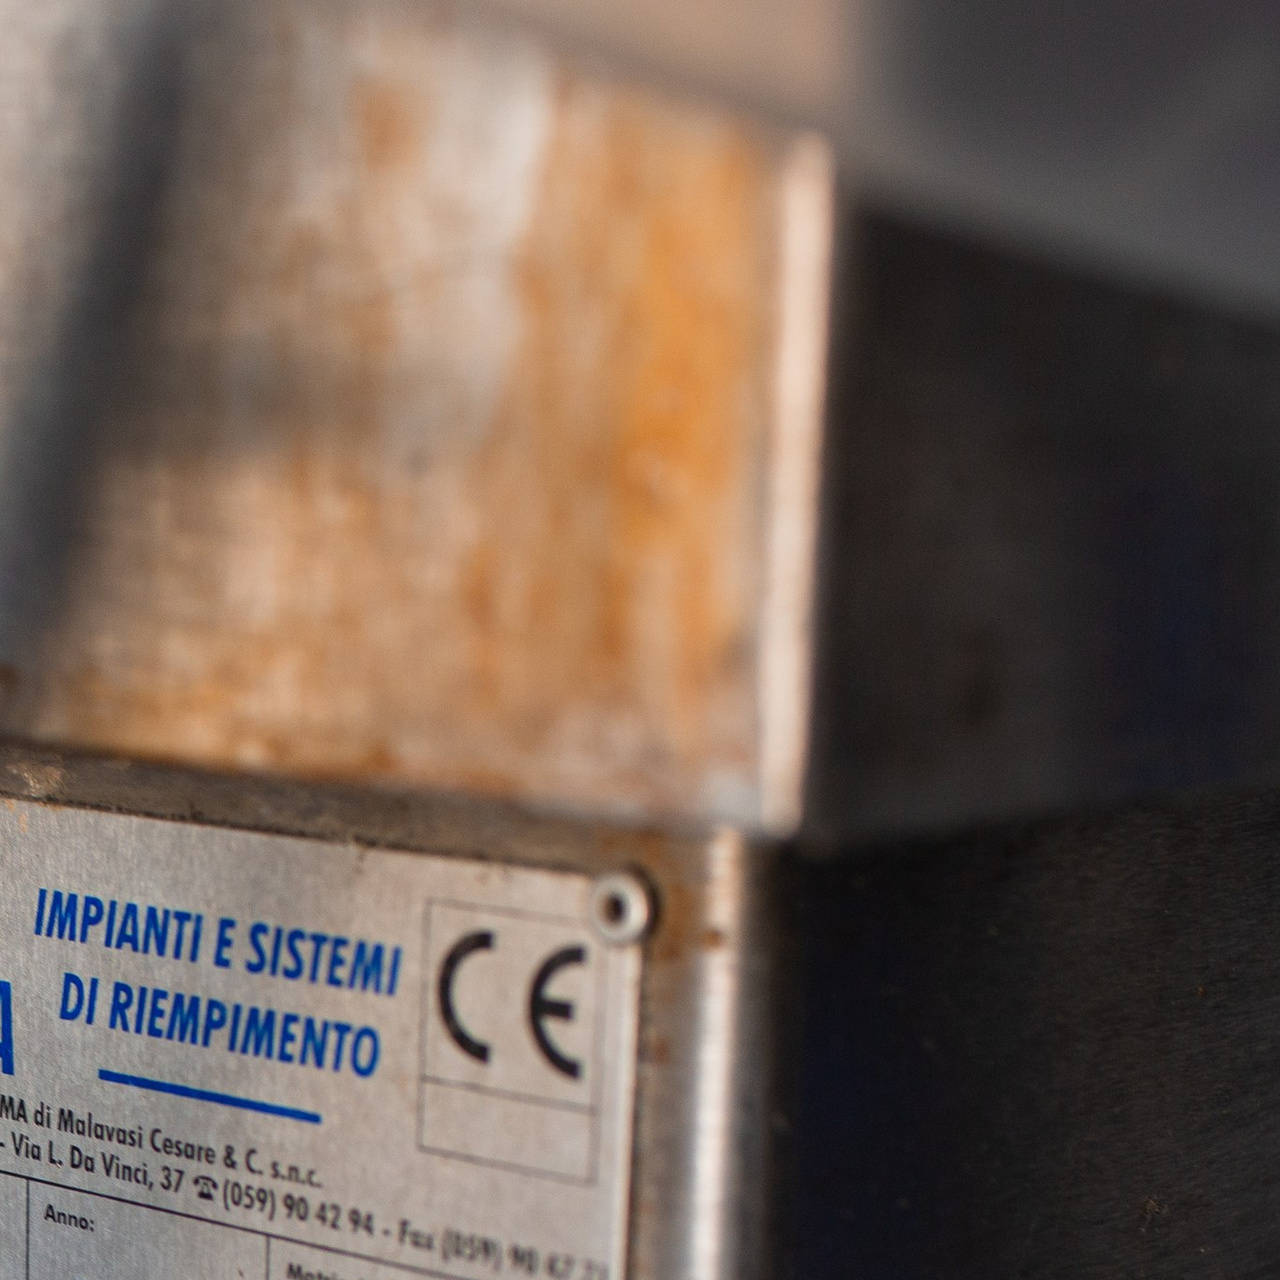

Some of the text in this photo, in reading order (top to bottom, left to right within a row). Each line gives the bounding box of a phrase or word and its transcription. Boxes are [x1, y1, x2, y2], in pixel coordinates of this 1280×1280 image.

[34, 888, 402, 996] IMPIANTI E SISTEMI
[59, 972, 381, 1078] DI RIEMPIMENTO
[438, 930, 587, 1081] CE
[11, 1131, 41, 1162] Via
[48, 1141, 63, 1166] L.
[70, 1146, 95, 1173] Da
[101, 1152, 154, 1191] Vinci,
[160, 1166, 185, 1193] 37
[223, 1179, 275, 1221] (059)
[284, 1193, 309, 1221] 90
[315, 1202, 340, 1229] 42
[349, 1208, 374, 1235] 94
[399, 1217, 434, 1251] Fax
[34, 1102, 51, 1130] di
[57, 1108, 143, 1149] Malavasi
[150, 1128, 216, 1165] Cesare
[223, 1145, 237, 1170] &
[245, 1148, 264, 1175] C.
[271, 1161, 322, 1188] s.n.c.
[44, 1203, 95, 1232] Anno:
